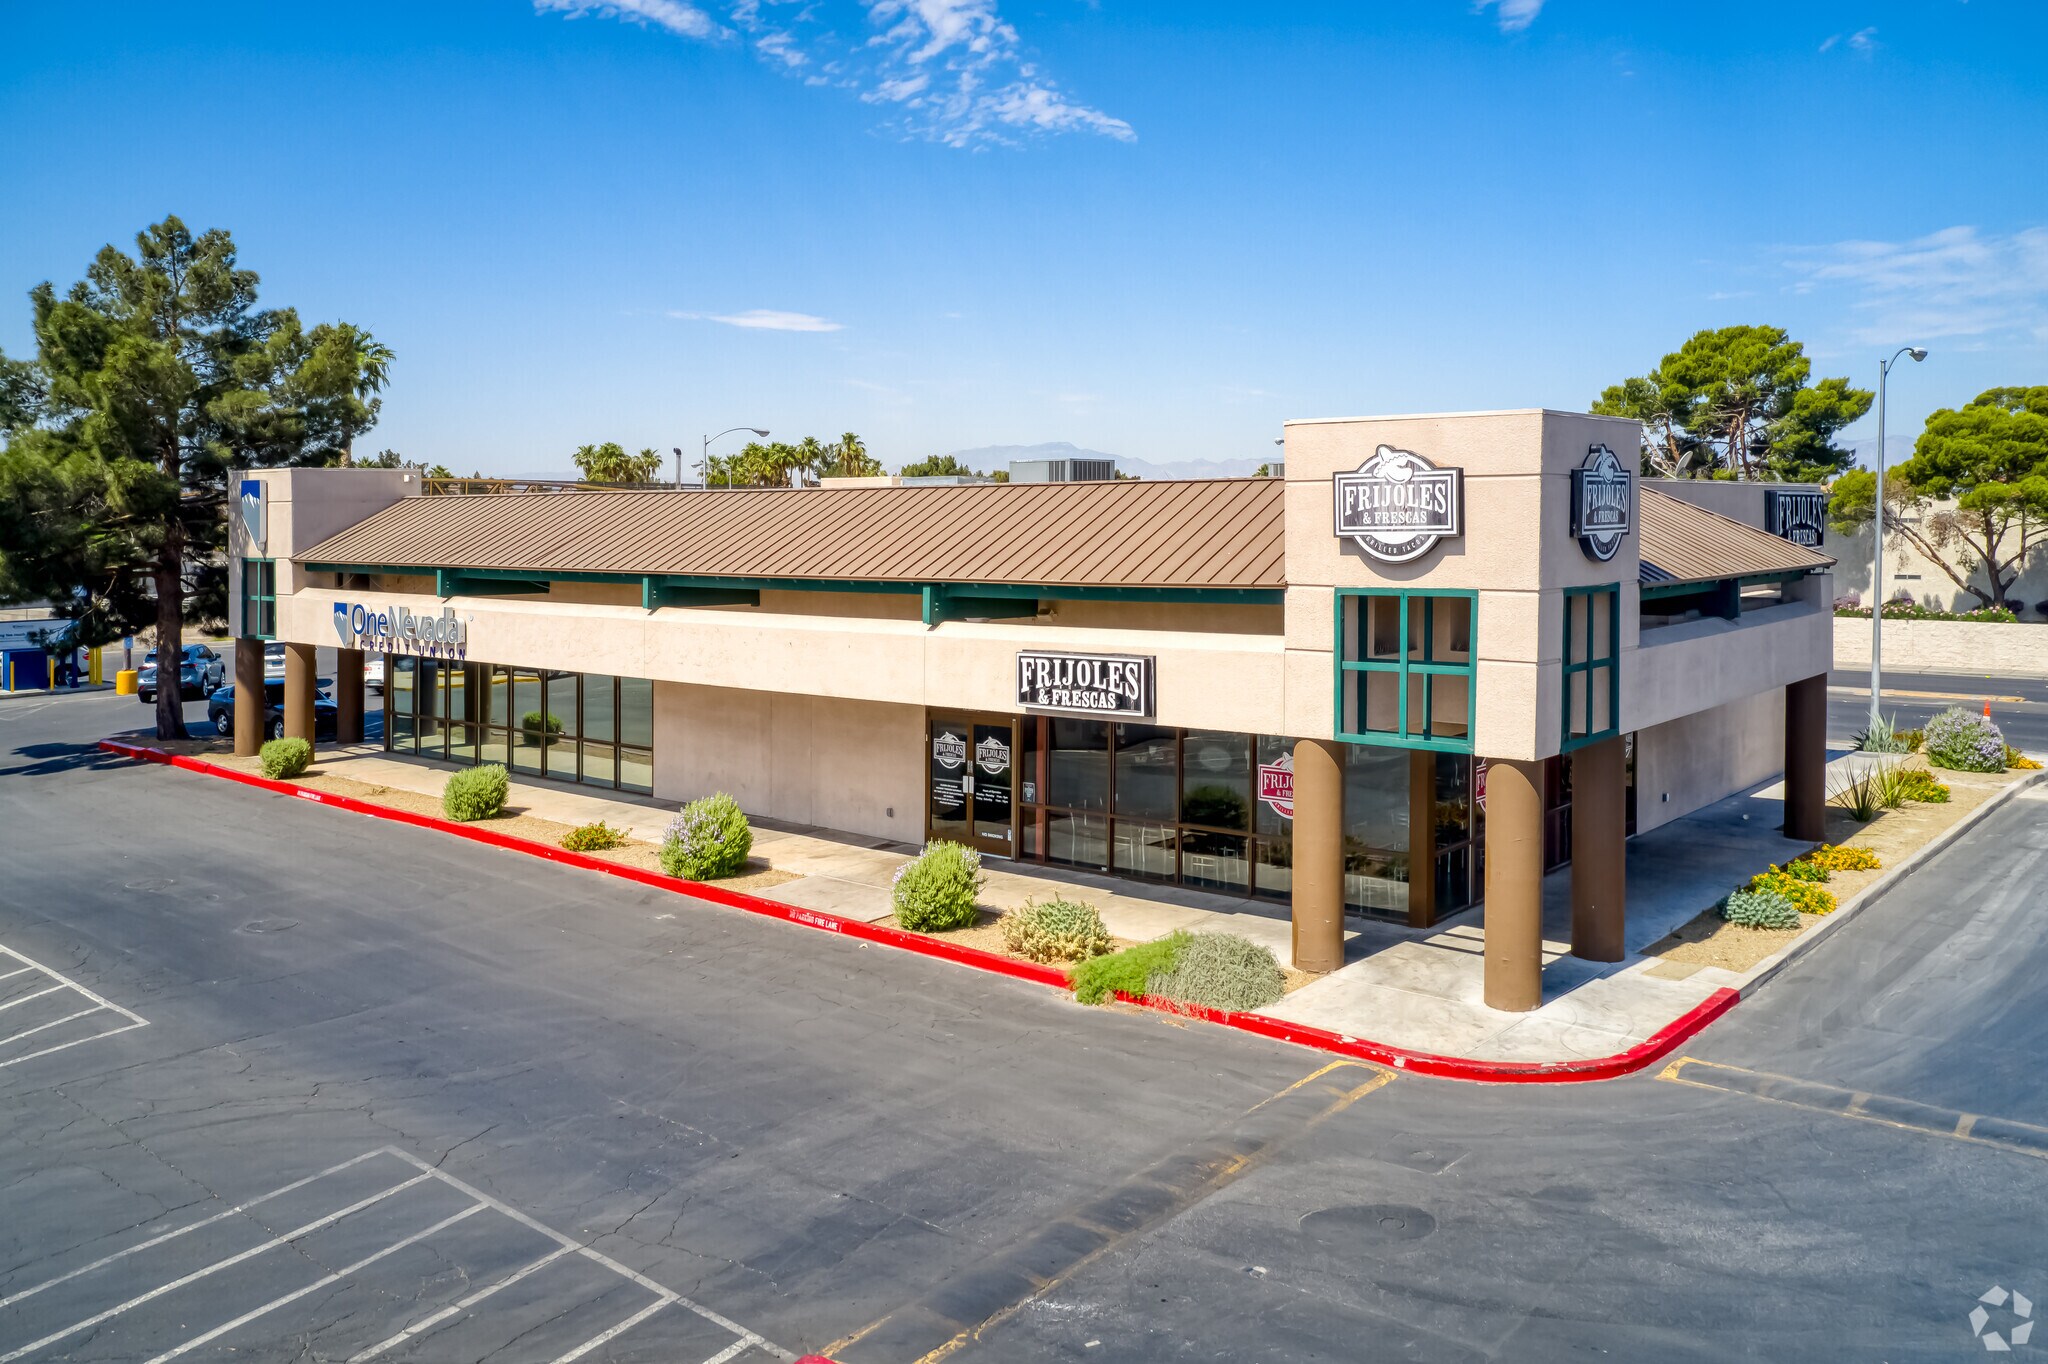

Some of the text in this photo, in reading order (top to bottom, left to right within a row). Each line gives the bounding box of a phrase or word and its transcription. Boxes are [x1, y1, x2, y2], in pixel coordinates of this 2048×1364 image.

[1344, 483, 1447, 516] FRIJOLES
[1587, 484, 1626, 515] FRIJOLES
[1362, 511, 1427, 524] & FRESCAS
[1779, 496, 1823, 535] FRIJOLES
[1365, 535, 1425, 554] GRILLED TACOS
[351, 603, 461, 643] OneNevada
[360, 640, 466, 660] CREDIT UNION
[1020, 657, 1139, 700] FRIJOLES
[1038, 687, 1117, 709] & FRESCAS
[936, 743, 963, 756] FRIJOLES
[980, 748, 1007, 761] FRIJOLES
[814, 917, 825, 927] FIRE
[825, 920, 838, 930] LANE
